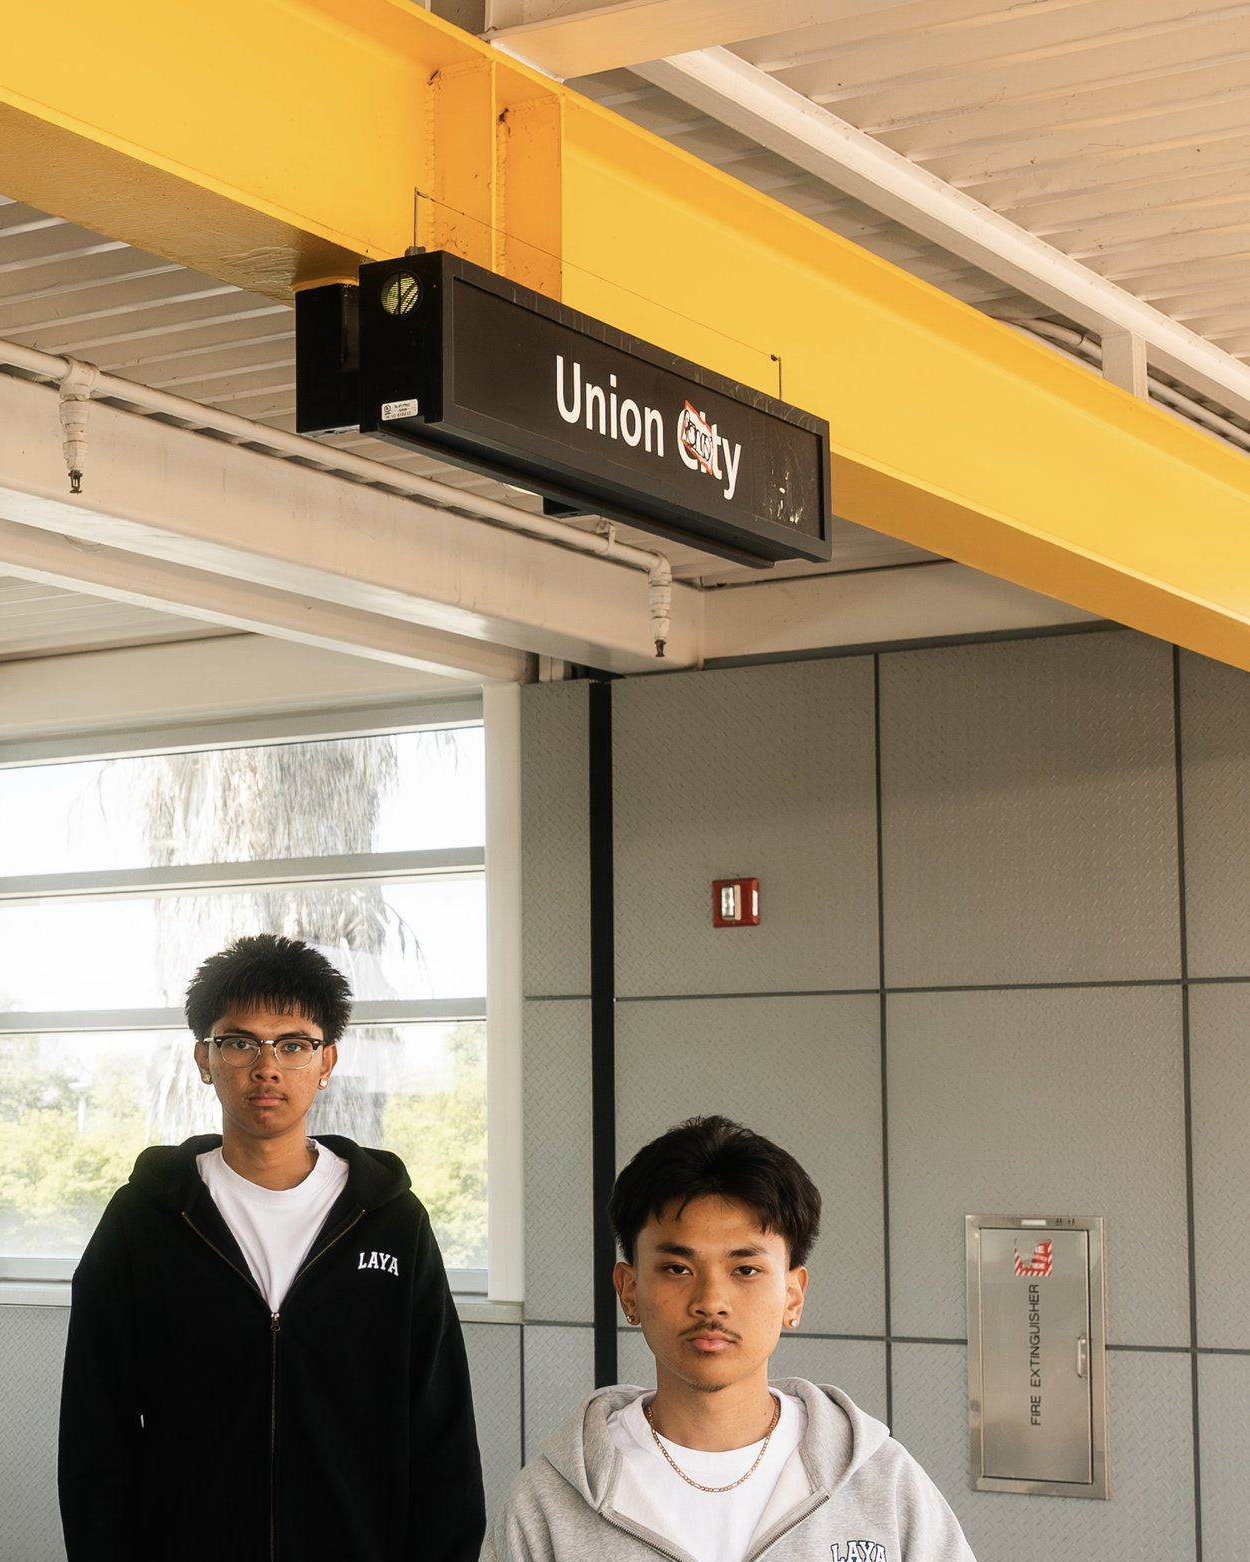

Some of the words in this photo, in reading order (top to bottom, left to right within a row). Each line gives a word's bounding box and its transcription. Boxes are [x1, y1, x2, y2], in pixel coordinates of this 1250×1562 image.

[556, 355, 665, 458] Union
[357, 1251, 399, 1277] LAYA
[1028, 1284, 1041, 1388] EXTINGUISHER
[1030, 1395, 1042, 1426] FIRE
